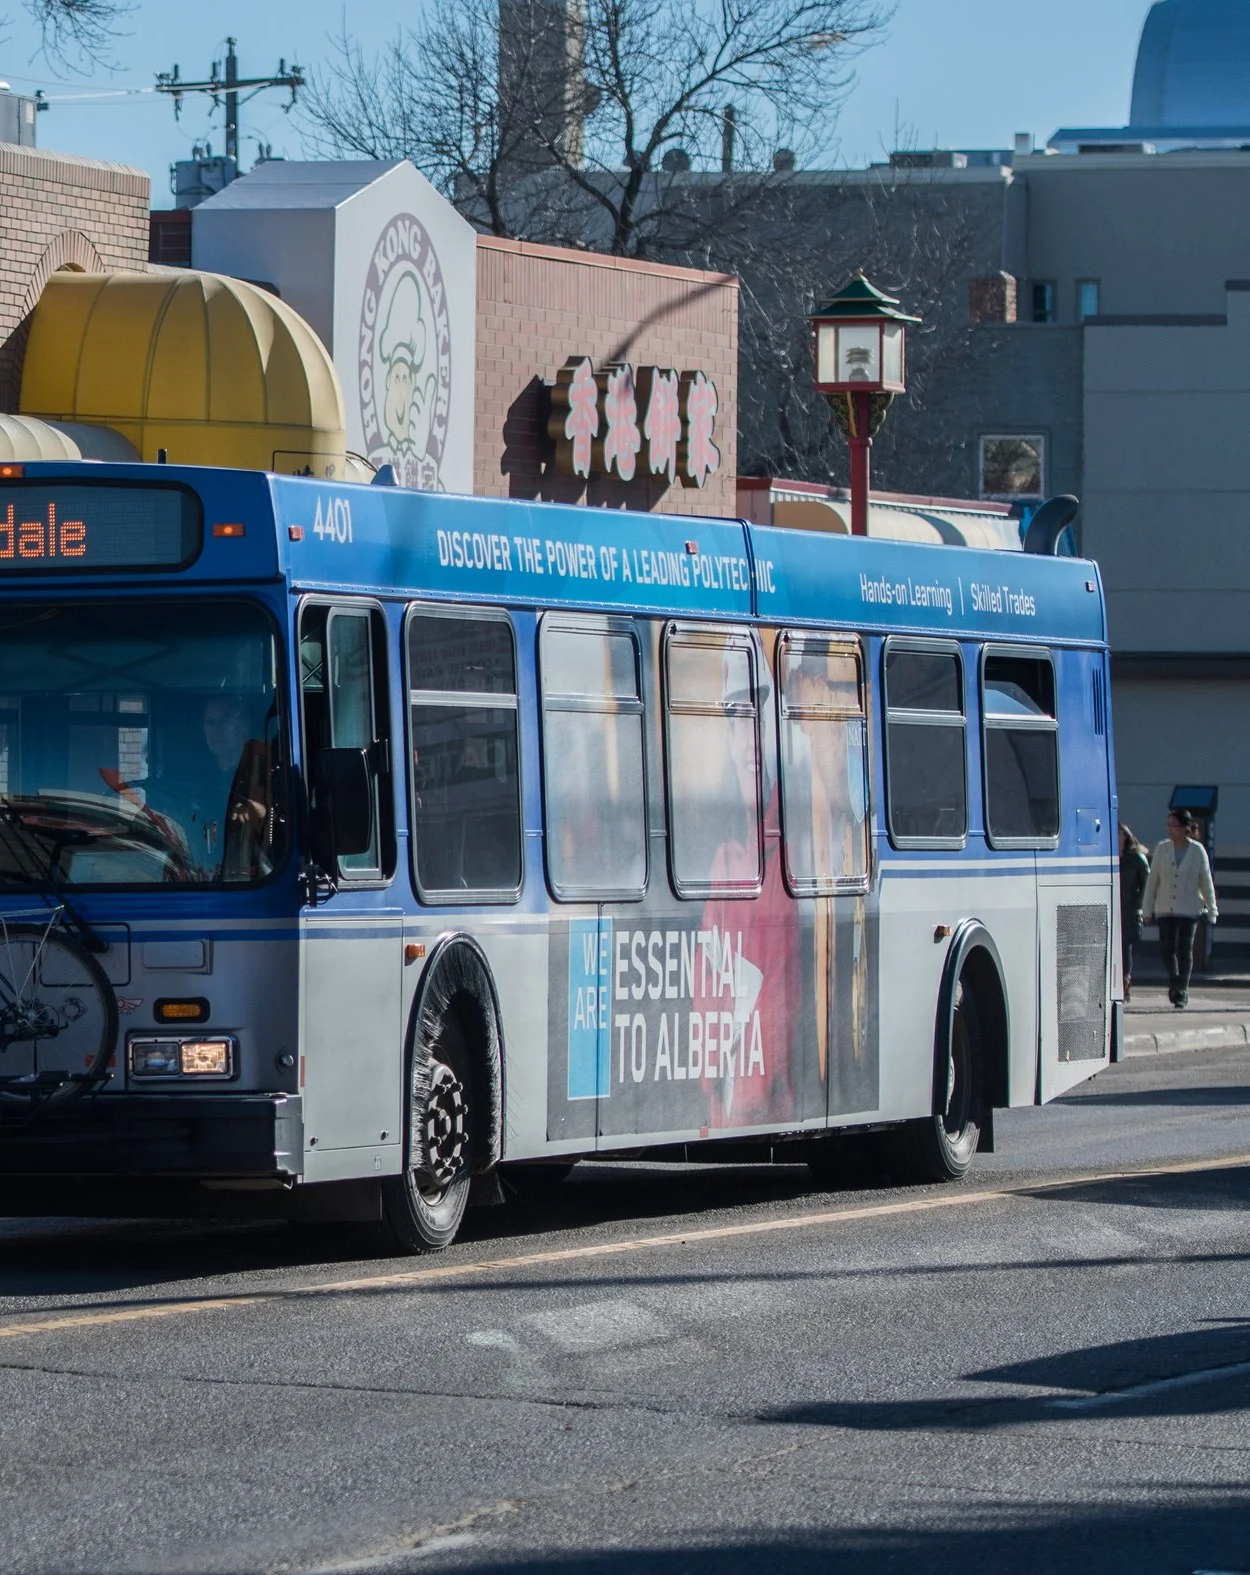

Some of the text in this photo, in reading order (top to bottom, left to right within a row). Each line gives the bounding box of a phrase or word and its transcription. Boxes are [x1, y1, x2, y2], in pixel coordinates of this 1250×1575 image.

[374, 219, 421, 287] KONG
[313, 494, 353, 544] 4401
[436, 529, 513, 572] DISCOVER
[513, 536, 544, 574] THE
[546, 539, 598, 580] POWER
[601, 547, 618, 581] OF
[622, 548, 632, 583] A
[635, 549, 690, 587] LEADING
[859, 572, 953, 616] Hands-on Learning
[970, 582, 1036, 616] Skilled Trades
[583, 931, 607, 977] WE
[615, 930, 749, 1000] ESSENTIAL
[573, 986, 607, 1031] ARE
[614, 1010, 765, 1084] TO ALBERTA
